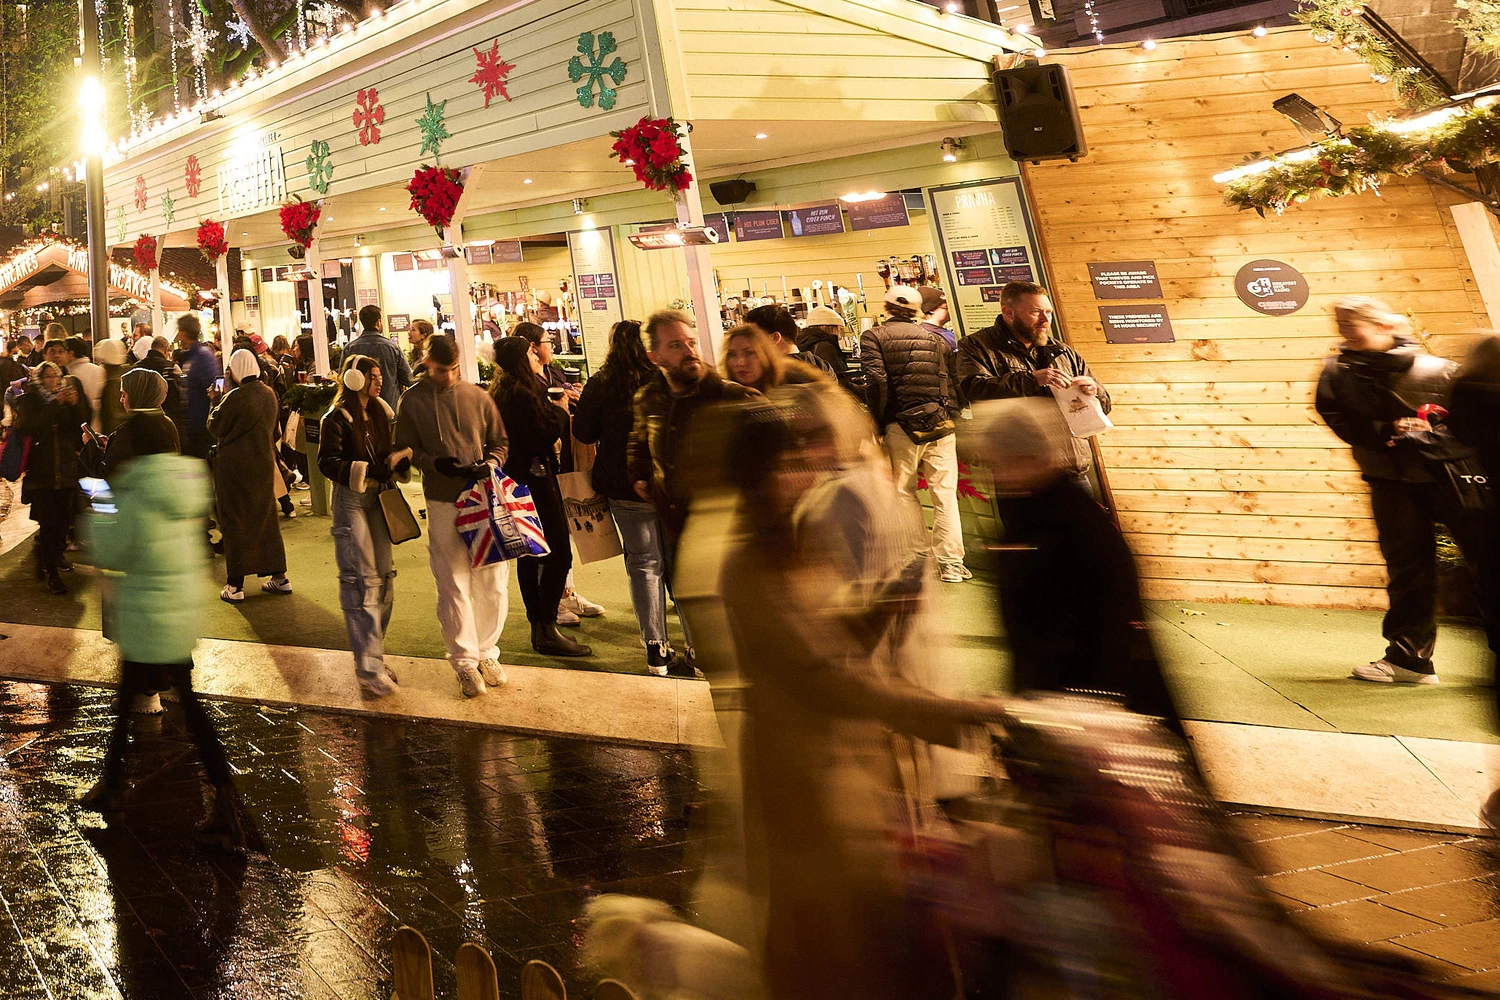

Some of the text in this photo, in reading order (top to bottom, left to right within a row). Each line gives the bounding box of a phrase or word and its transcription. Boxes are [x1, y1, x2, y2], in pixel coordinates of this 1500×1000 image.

[955, 192, 996, 209] PRAVHA
[820, 214, 835, 222] PUNCH
[109, 263, 155, 303] NCAKES
[1460, 474, 1488, 484] TO
